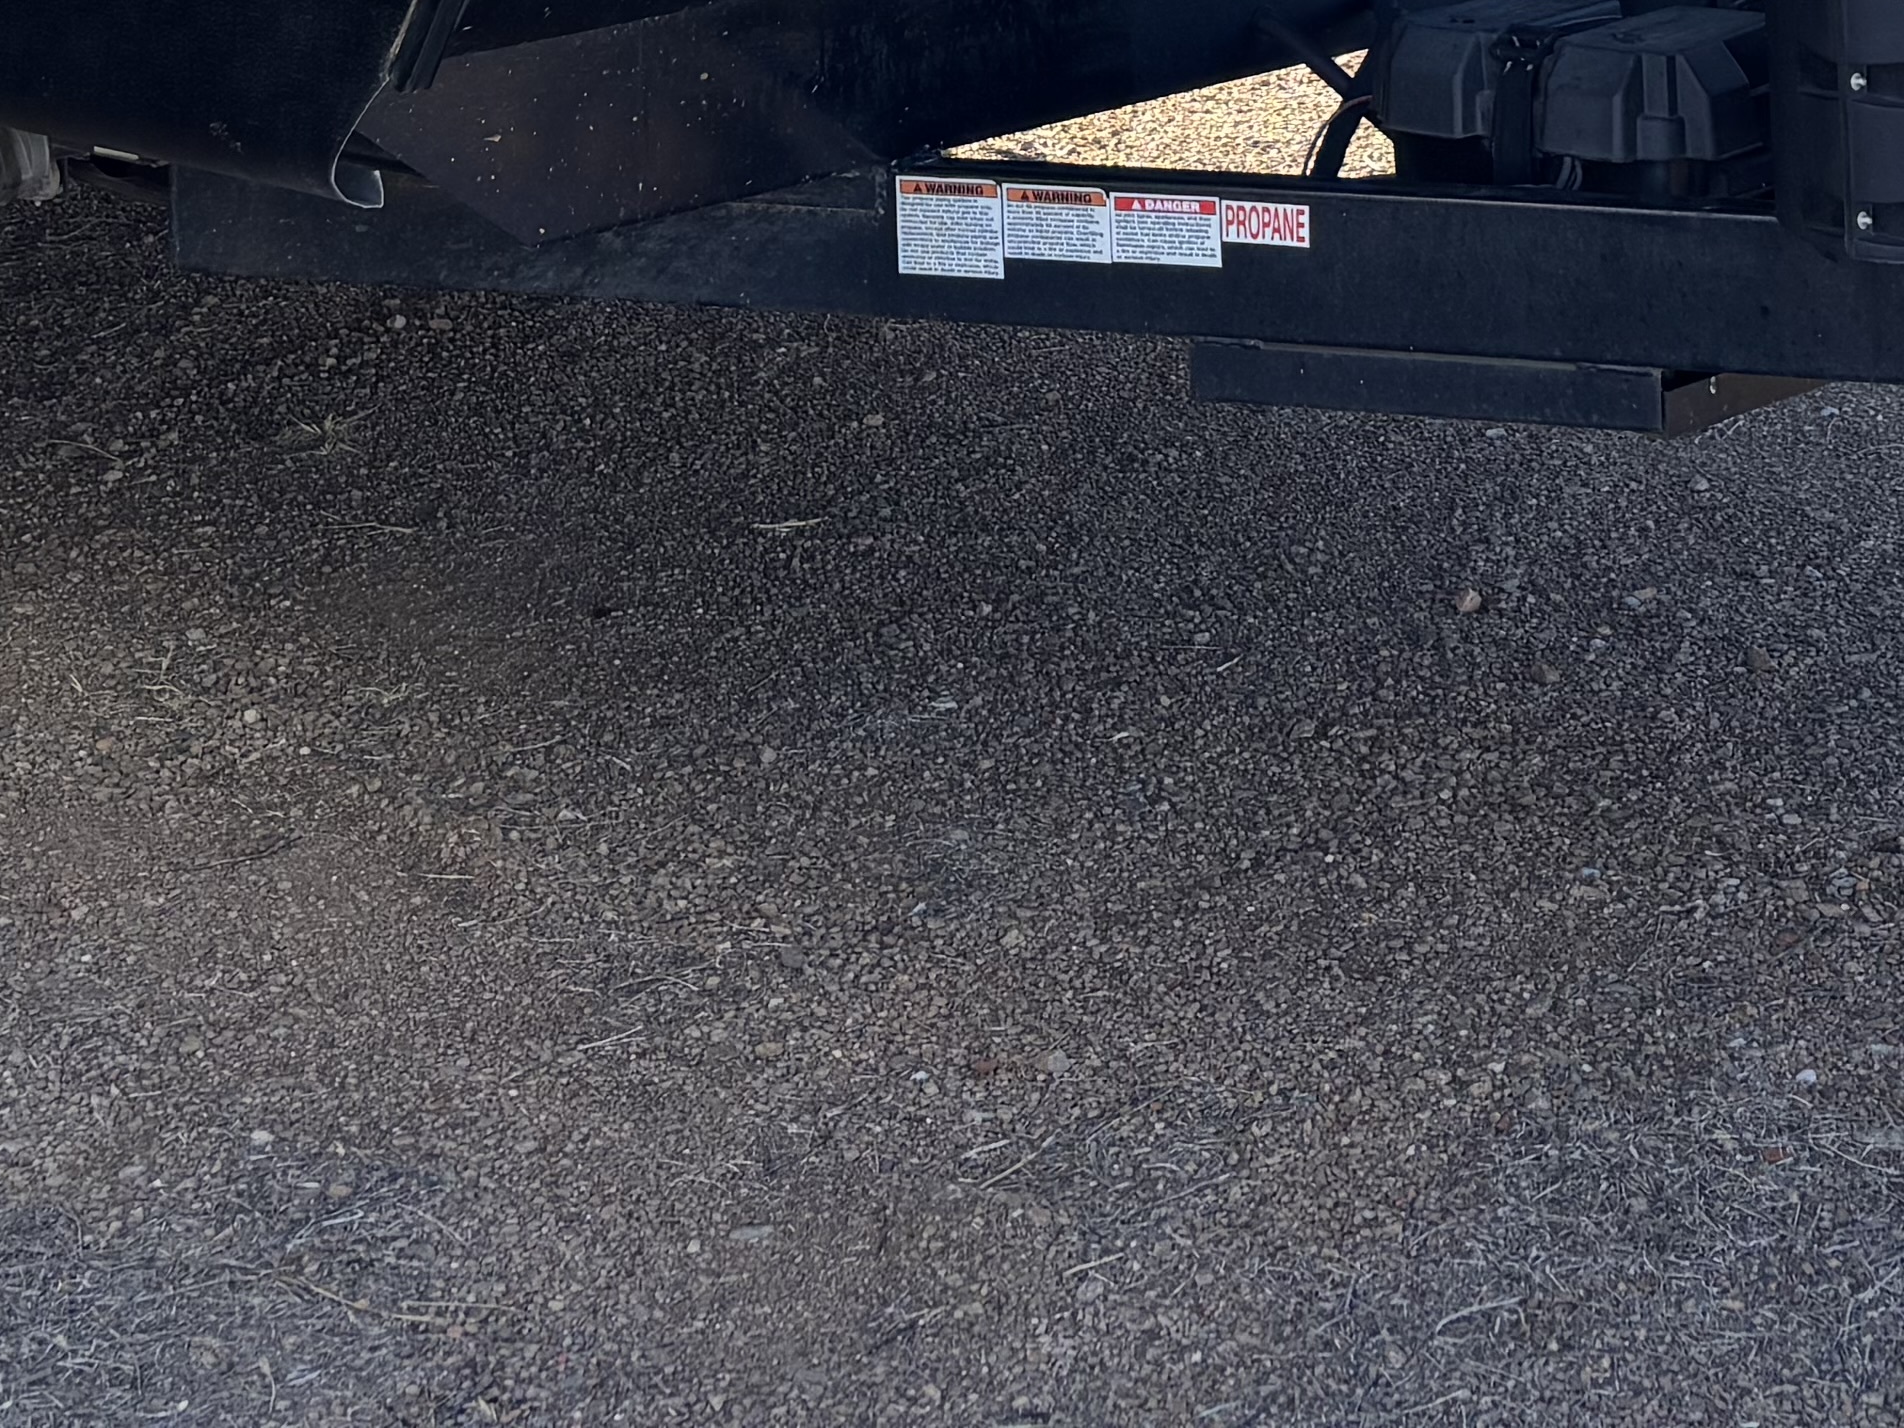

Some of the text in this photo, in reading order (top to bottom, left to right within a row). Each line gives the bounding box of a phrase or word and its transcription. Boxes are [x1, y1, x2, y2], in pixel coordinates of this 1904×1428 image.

[924, 182, 984, 196] WARNING
[1031, 190, 1092, 204] WARNING
[1144, 198, 1201, 213] DANGER
[1225, 204, 1306, 243] PROPANE
